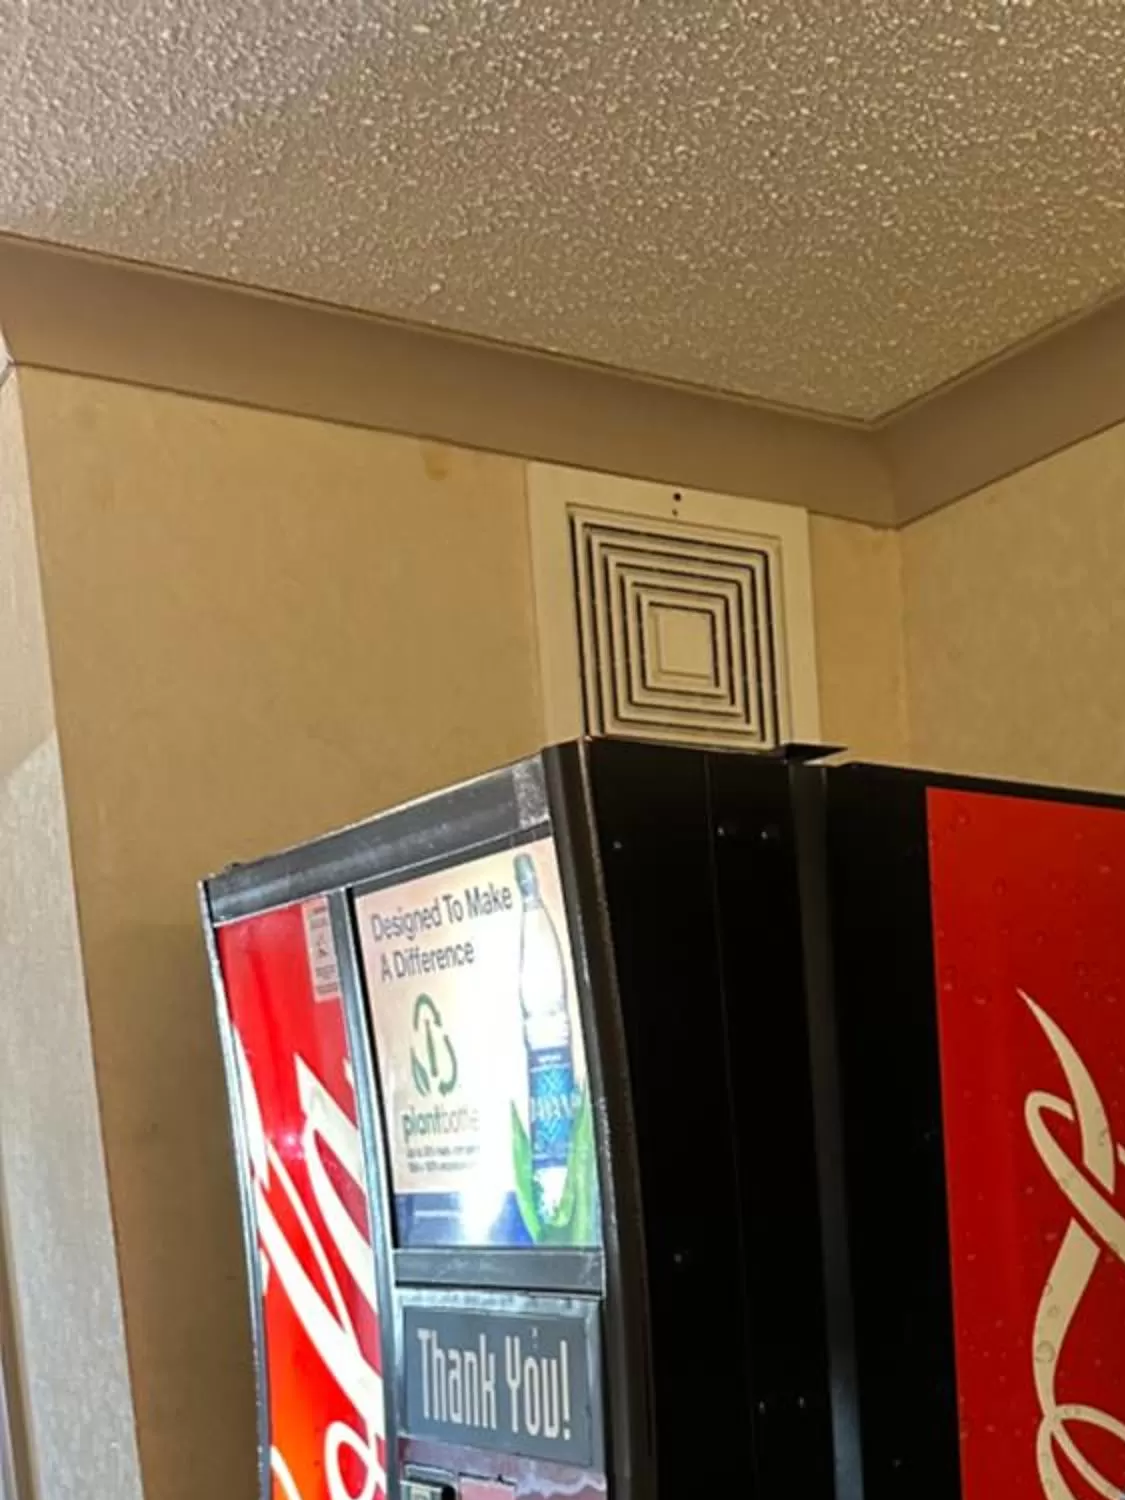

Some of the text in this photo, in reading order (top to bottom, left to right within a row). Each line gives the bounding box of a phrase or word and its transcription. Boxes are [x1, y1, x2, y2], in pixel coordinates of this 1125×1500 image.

[371, 881, 513, 941] Designed To Make
[381, 941, 475, 982] A Difference
[417, 1328, 572, 1442] Thank You!
